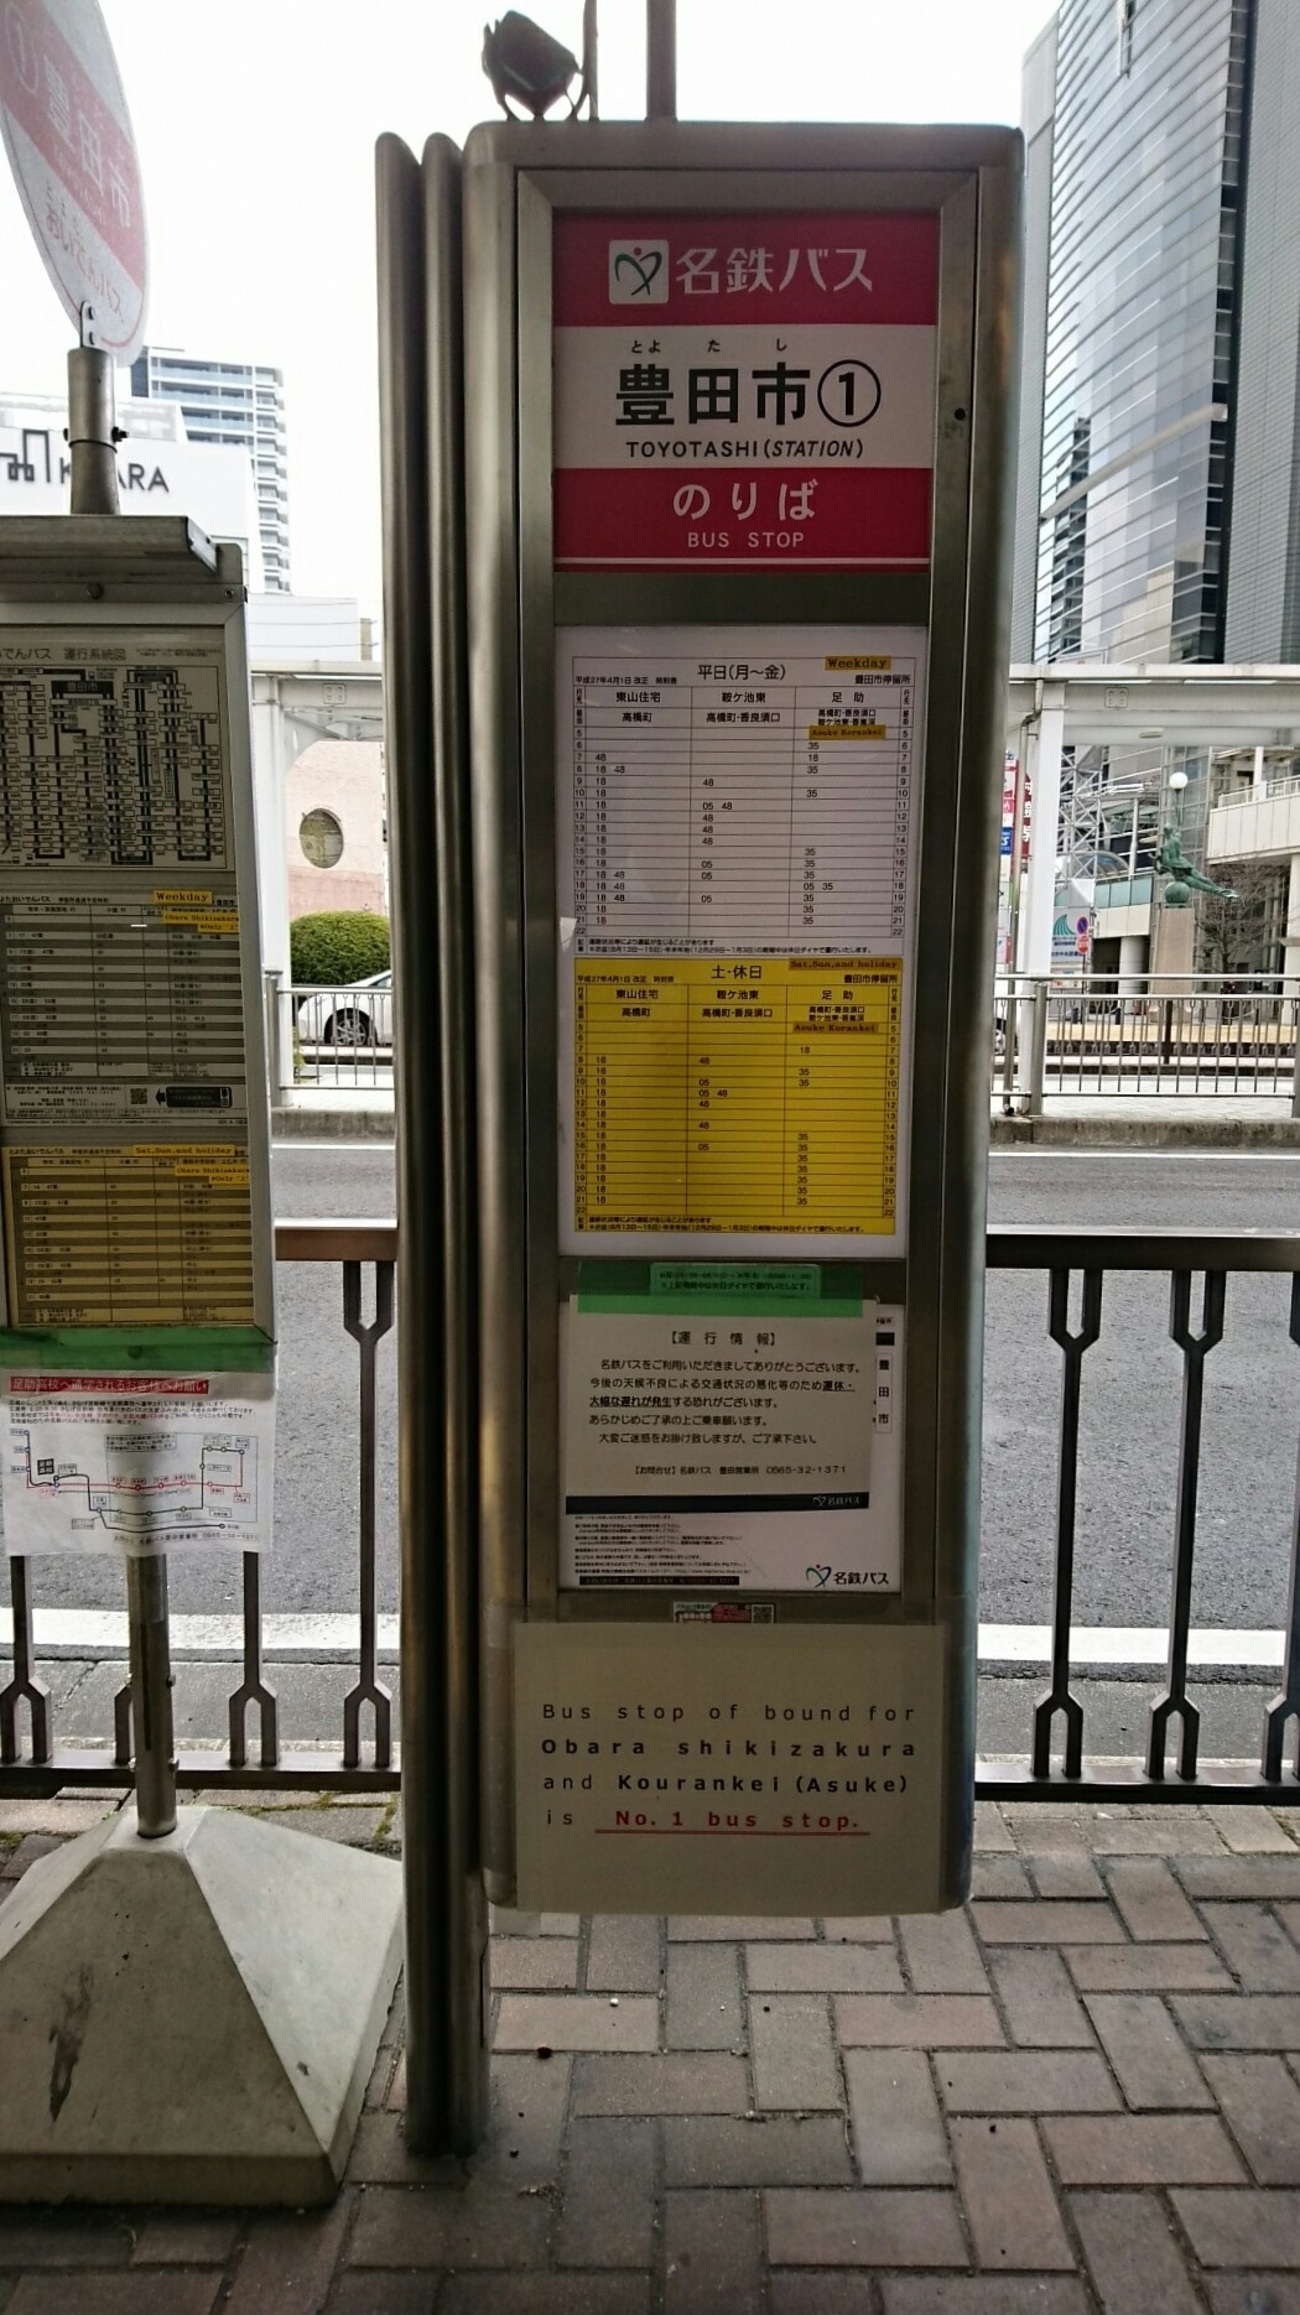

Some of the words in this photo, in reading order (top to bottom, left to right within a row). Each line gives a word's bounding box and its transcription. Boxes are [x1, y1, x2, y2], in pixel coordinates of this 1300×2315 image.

[676, 248, 872, 293] 名鉄バス
[60, 457, 169, 492] KRA
[673, 479, 818, 520] のりば
[688, 532, 729, 548] BUS
[748, 532, 804, 548] STOP
[828, 658, 886, 669] Weekday
[616, 692, 661, 703] 東山住宅
[623, 712, 652, 722] 高橋町
[808, 742, 819, 750] 35
[596, 765, 606, 773] 18
[702, 802, 713, 810] 05
[721, 802, 733, 810] 48
[596, 824, 607, 832] 18
[596, 836, 607, 844] 18
[596, 859, 607, 867] 18
[804, 871, 815, 879] 35
[596, 882, 607, 890] 18
[156, 891, 208, 902] Weekday
[803, 905, 814, 913] 35
[596, 916, 607, 924] 18
[857, 960, 897, 969] holiday
[712, 966, 761, 979] 土・休日
[616, 990, 658, 1000] 東山住宅
[622, 1008, 650, 1017] 高橋町
[828, 1024, 875, 1032] Korankei
[800, 1046, 810, 1054] 18
[596, 1056, 606, 1064] 18
[596, 1067, 606, 1075] 18
[699, 1089, 710, 1097] 05
[717, 1089, 728, 1097] 48
[596, 1121, 606, 1129] 18
[798, 1133, 808, 1141] 35
[196, 1146, 232, 1155] holiday
[698, 1143, 709, 1151] 05
[596, 1164, 606, 1172] 18
[797, 1176, 807, 1184] 35
[601, 1359, 860, 1374] 名鉄バスをご利用いただきましてありがとうございます。
[589, 1415, 767, 1426] あらかじめご了承の上ご乗車願います。
[834, 1572, 889, 1585] 名鉄バス
[543, 1704, 591, 1719] Bus
[617, 1704, 684, 1722] stop
[709, 1704, 738, 1719] of
[765, 1705, 851, 1721] bound
[869, 1706, 914, 1721] for
[541, 1739, 645, 1754] Obara
[678, 1739, 914, 1756] shikizakura
[543, 1774, 593, 1790] and
[618, 1775, 779, 1792] Kourankei
[795, 1776, 908, 1793] (Asuke)
[546, 1810, 573, 1825] is
[615, 1810, 655, 1825] No.
[672, 1812, 683, 1825] 1
[708, 1811, 757, 1827] bus
[783, 1812, 859, 1830] stop.
